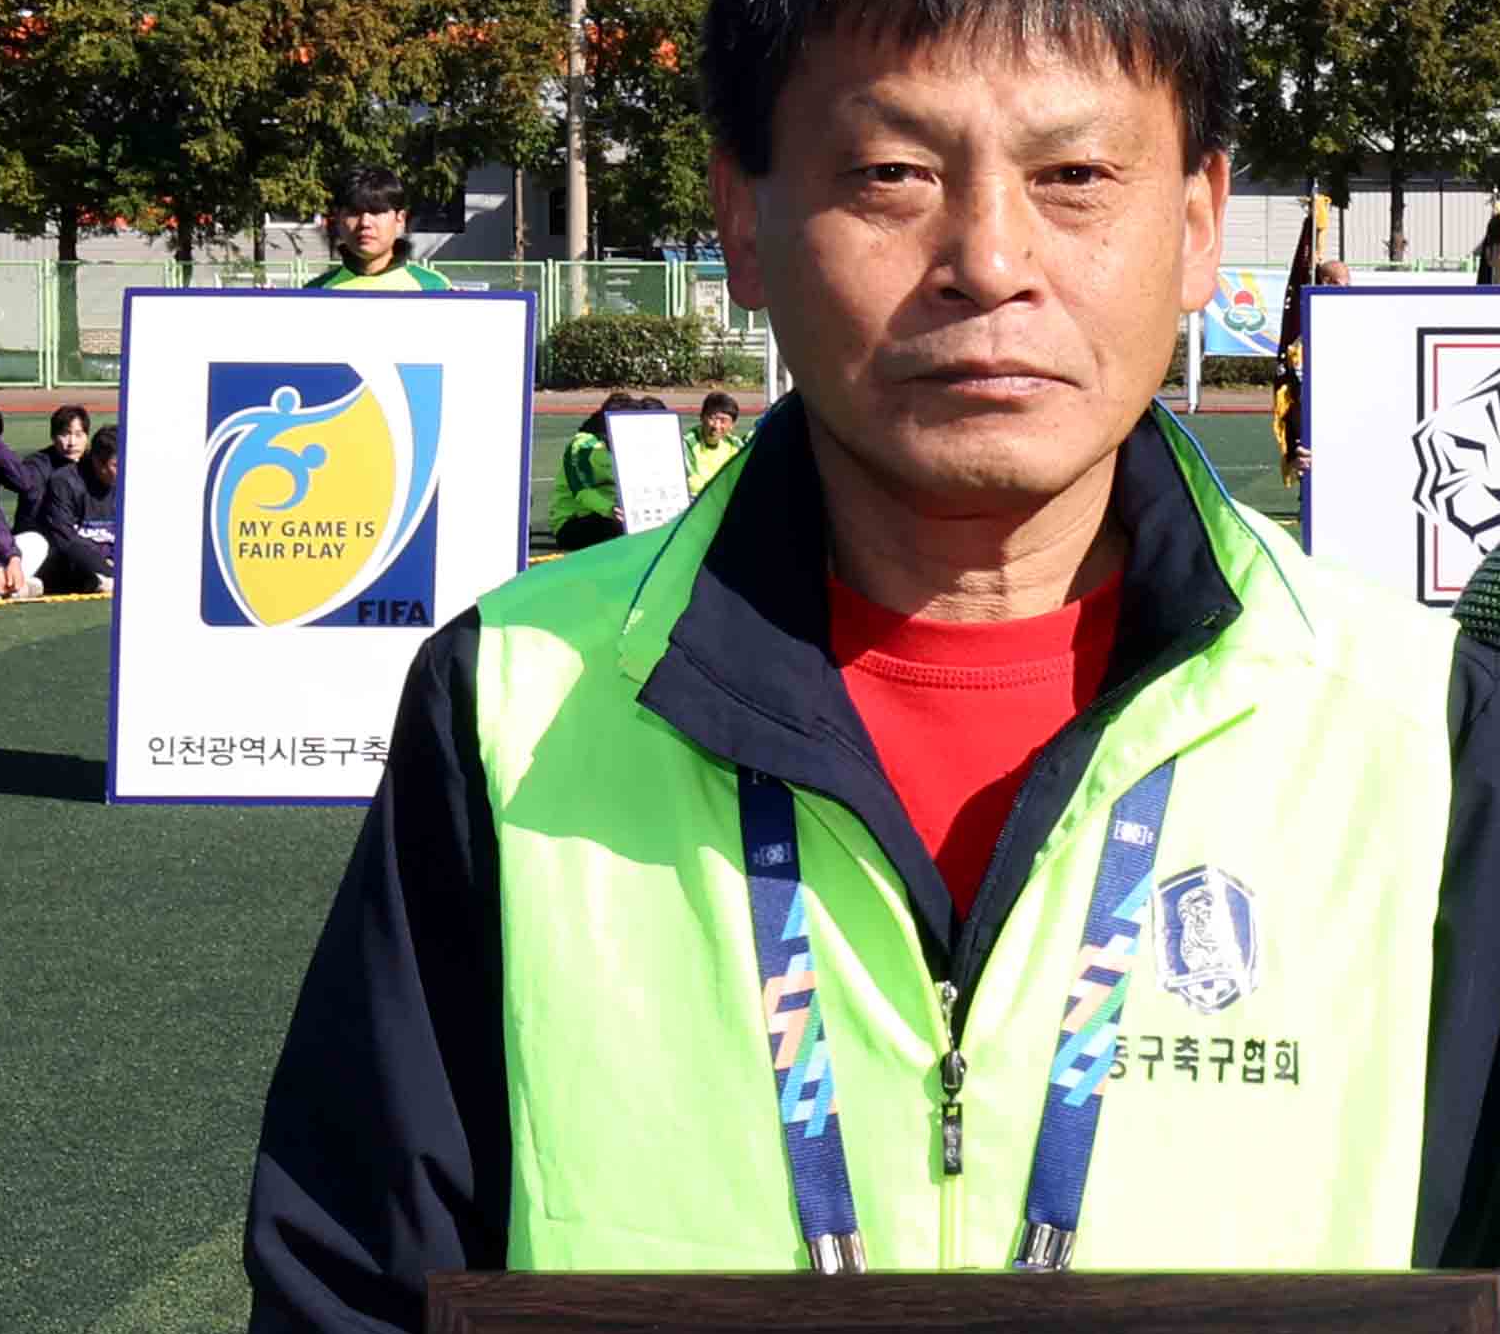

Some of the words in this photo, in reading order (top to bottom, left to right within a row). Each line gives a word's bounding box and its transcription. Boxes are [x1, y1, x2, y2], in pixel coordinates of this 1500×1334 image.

[239, 521, 273, 537] MY
[281, 521, 346, 537] GAME
[356, 521, 375, 537] IS
[238, 542, 285, 559] FAIR
[293, 542, 345, 559] PLAY
[357, 599, 430, 626] FIFA
